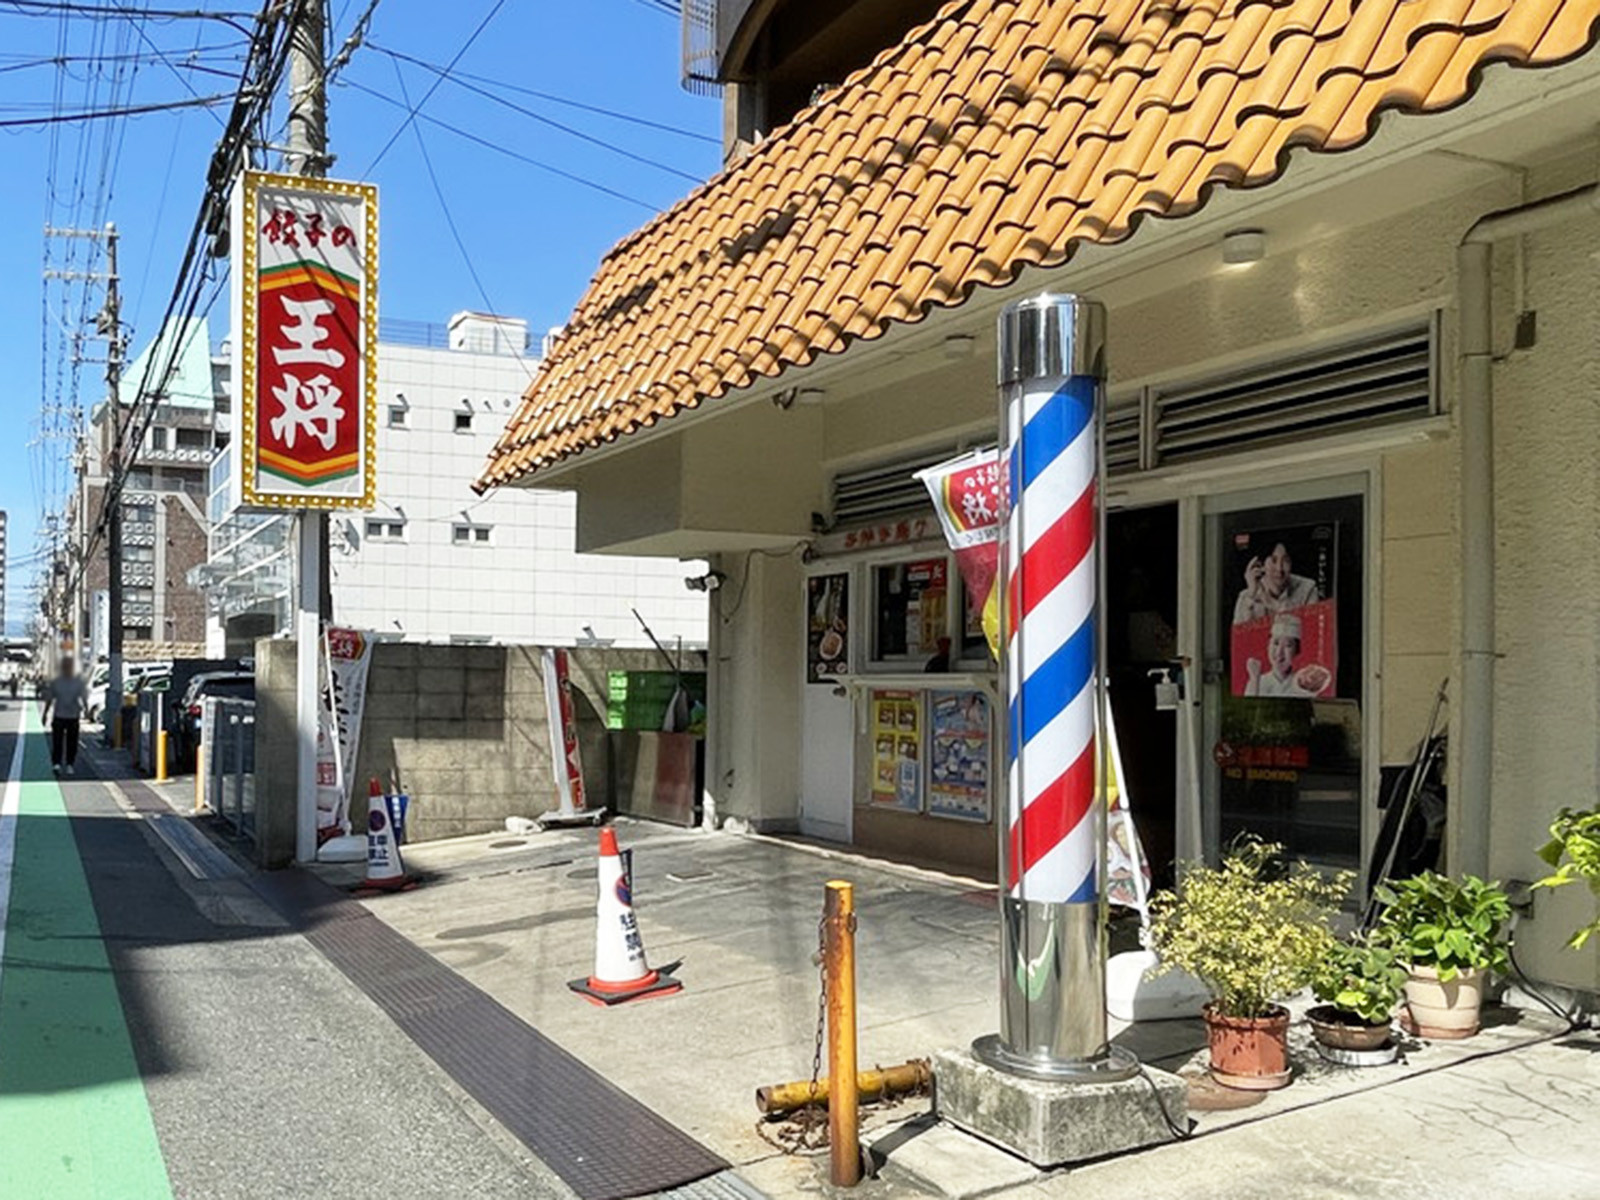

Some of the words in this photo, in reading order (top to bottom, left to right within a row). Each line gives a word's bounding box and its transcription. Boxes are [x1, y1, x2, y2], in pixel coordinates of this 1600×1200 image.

[262, 208, 357, 249] 餃子の
[270, 294, 346, 452] 王将
